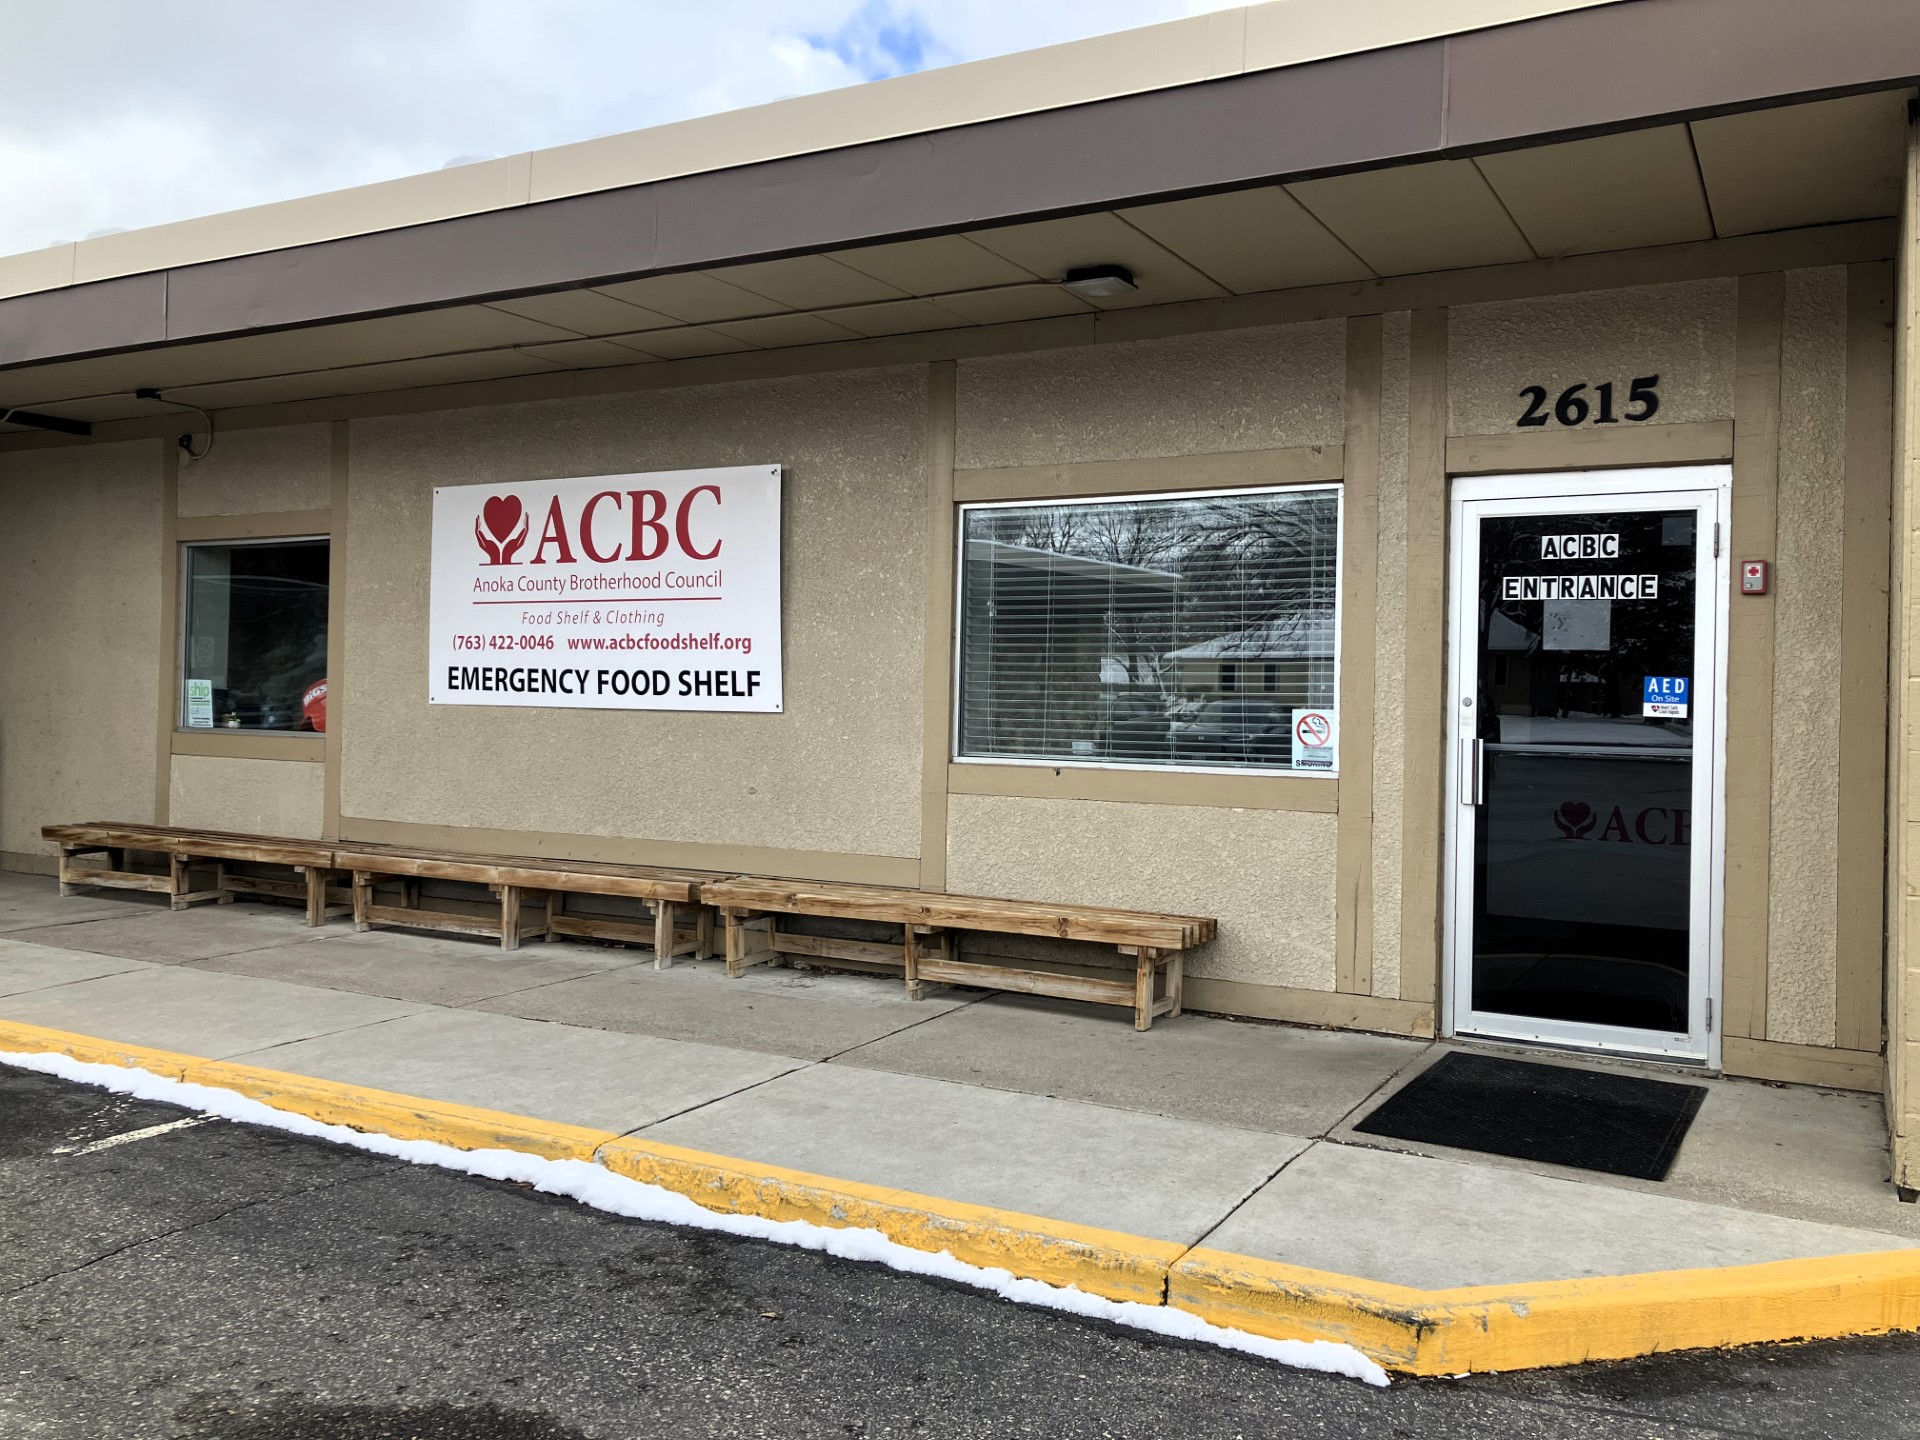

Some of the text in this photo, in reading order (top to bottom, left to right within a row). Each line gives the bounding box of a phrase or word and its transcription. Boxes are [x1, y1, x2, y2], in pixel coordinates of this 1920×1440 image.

[1516, 374, 1660, 427] 2615
[530, 485, 723, 565] ACBC
[1542, 535, 1617, 558] ACBC
[473, 569, 723, 595] Anoka County Brotherhood Council
[1504, 575, 1656, 599] ENTRANCE
[522, 609, 665, 627] Food Shelf & Clothing
[452, 632, 752, 654] (763) 422-0046 www.acbcfoodshelf.org
[448, 666, 761, 697] EMERGENCY FOOD SHELF
[1648, 677, 1685, 694] AED
[1651, 694, 1680, 703] On Site
